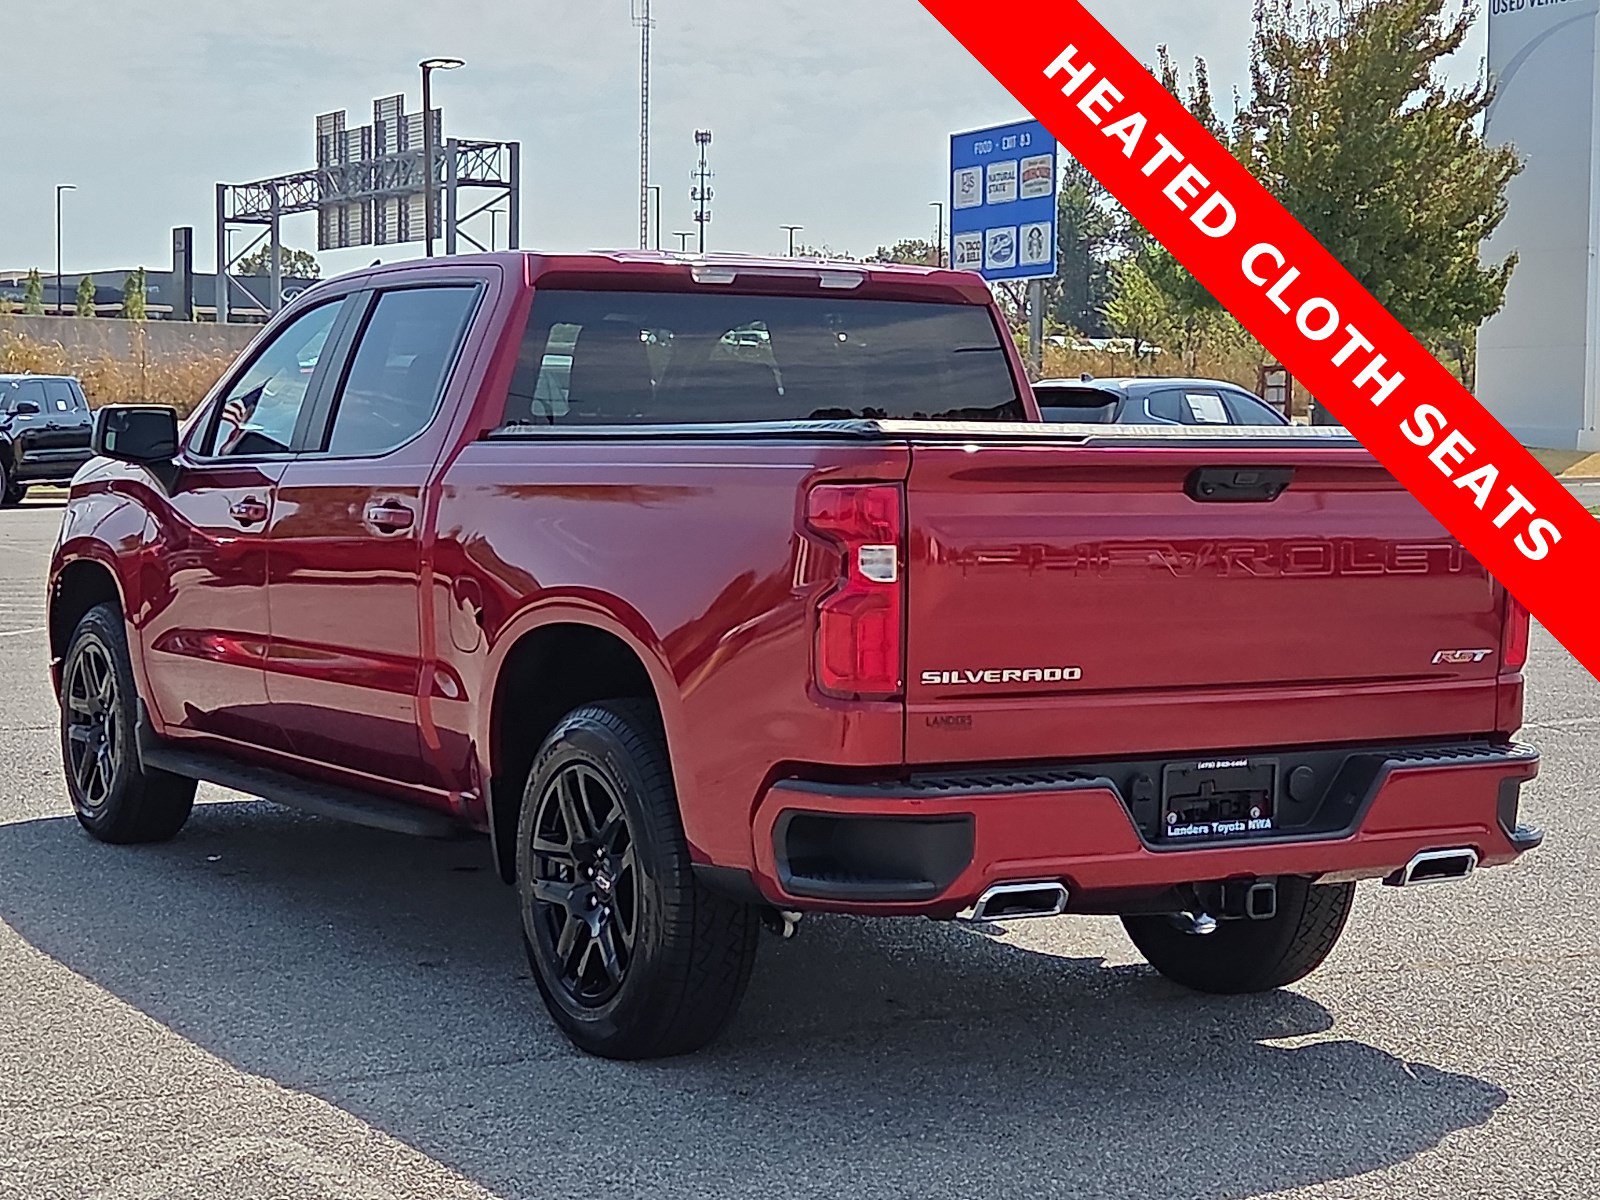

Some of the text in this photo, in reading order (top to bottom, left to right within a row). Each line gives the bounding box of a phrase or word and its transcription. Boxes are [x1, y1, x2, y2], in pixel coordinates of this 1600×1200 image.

[974, 140, 993, 155] FOOD
[1002, 135, 1017, 151] EXIT
[988, 171, 1015, 182] NATURAL
[988, 182, 1006, 194] STATE
[965, 241, 980, 251] TACO
[966, 251, 980, 262] BELL
[1431, 649, 1494, 664] RST
[921, 667, 1082, 685] SILVERADO
[926, 715, 972, 727] LANDERS
[1167, 818, 1272, 837] Landers Toyota NWA
